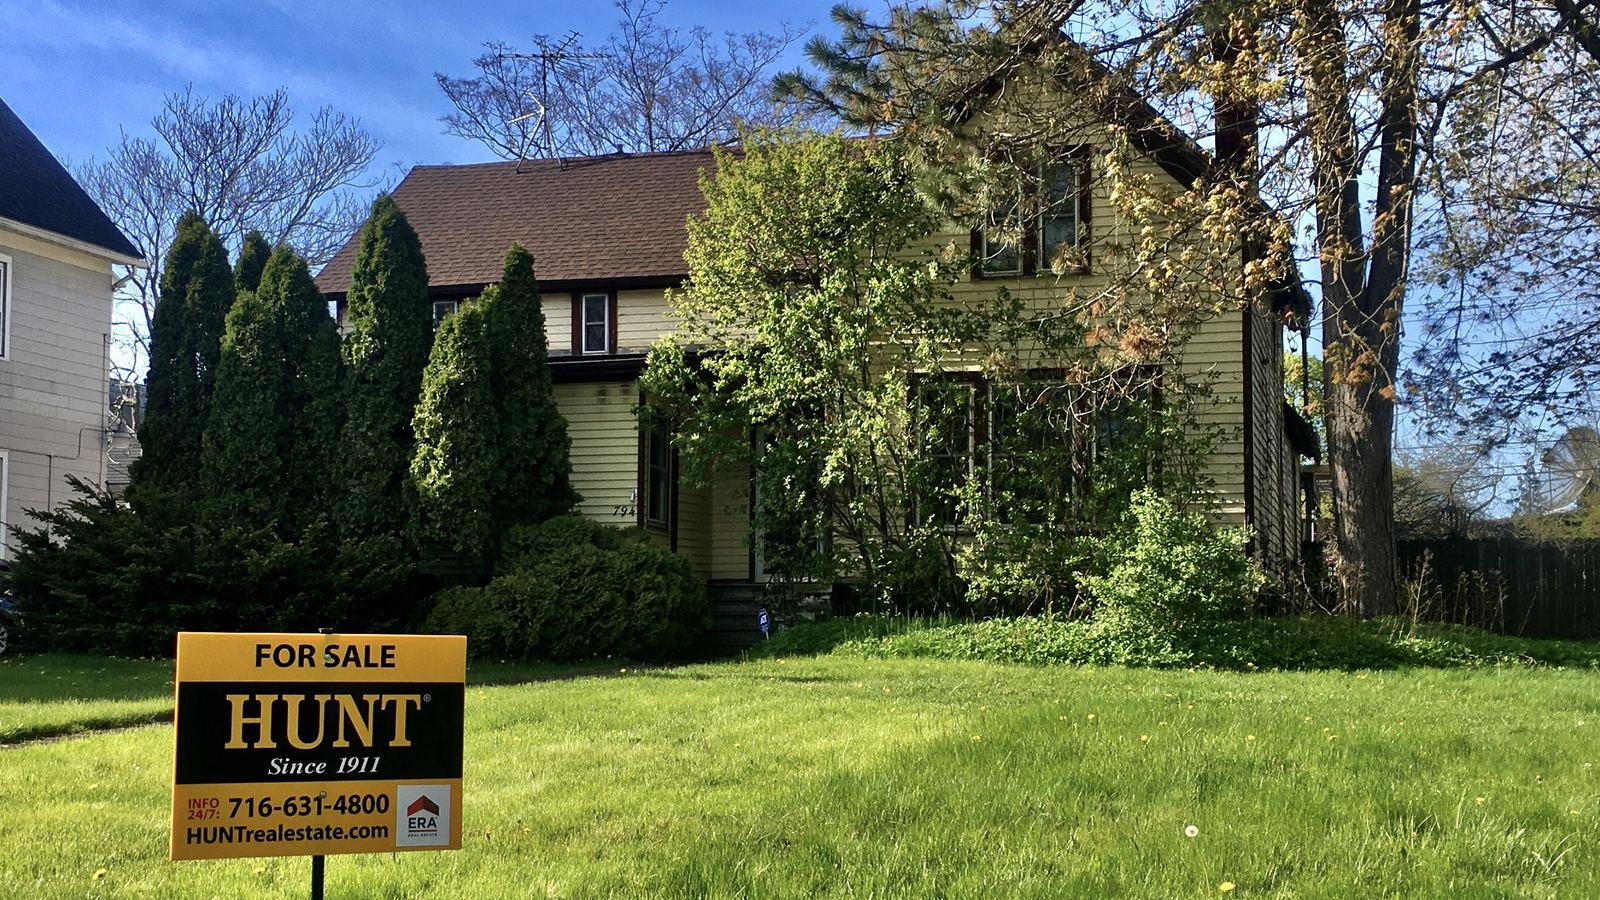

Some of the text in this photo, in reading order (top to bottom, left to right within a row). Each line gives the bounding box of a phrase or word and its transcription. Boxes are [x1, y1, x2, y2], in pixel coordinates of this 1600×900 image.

[613, 505, 635, 517] 794
[255, 644, 396, 668] FOR SALE
[224, 694, 421, 750] HUNT
[267, 756, 381, 775] Since 1911
[188, 798, 220, 809] INFO
[228, 793, 390, 819] 716-631-4800
[187, 810, 220, 820] 24/7:
[408, 817, 438, 829] ERA
[186, 823, 389, 845] HUNTrealestate.com
